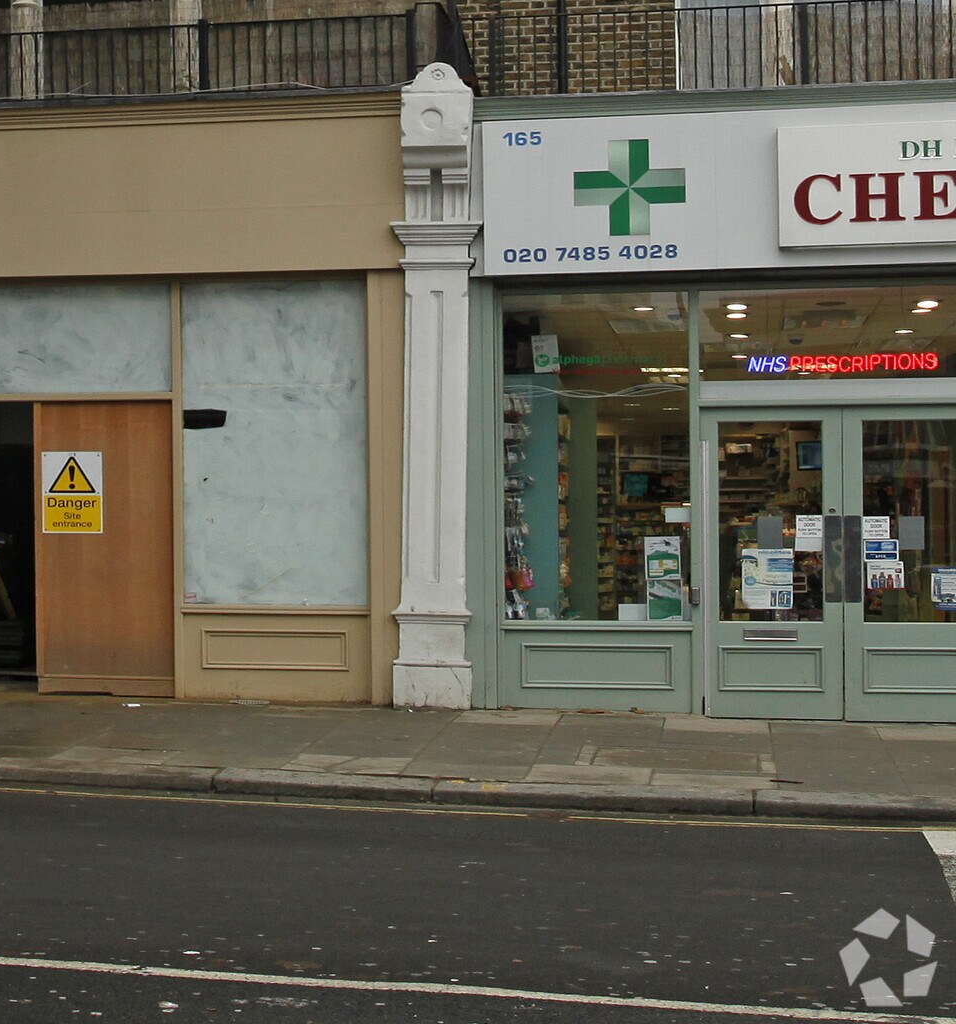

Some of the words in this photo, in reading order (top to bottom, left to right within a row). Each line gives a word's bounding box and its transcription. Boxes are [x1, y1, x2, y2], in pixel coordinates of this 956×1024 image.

[502, 131, 542, 147] 165
[899, 139, 943, 159] DH
[793, 170, 956, 226] CHE
[503, 248, 547, 263] 020
[555, 246, 610, 262] 7485
[619, 244, 678, 261] 4028
[747, 355, 787, 373] NHS
[788, 352, 938, 374] PRESCRIPTIONS
[47, 497, 96, 510] Danger
[64, 512, 81, 520] Site
